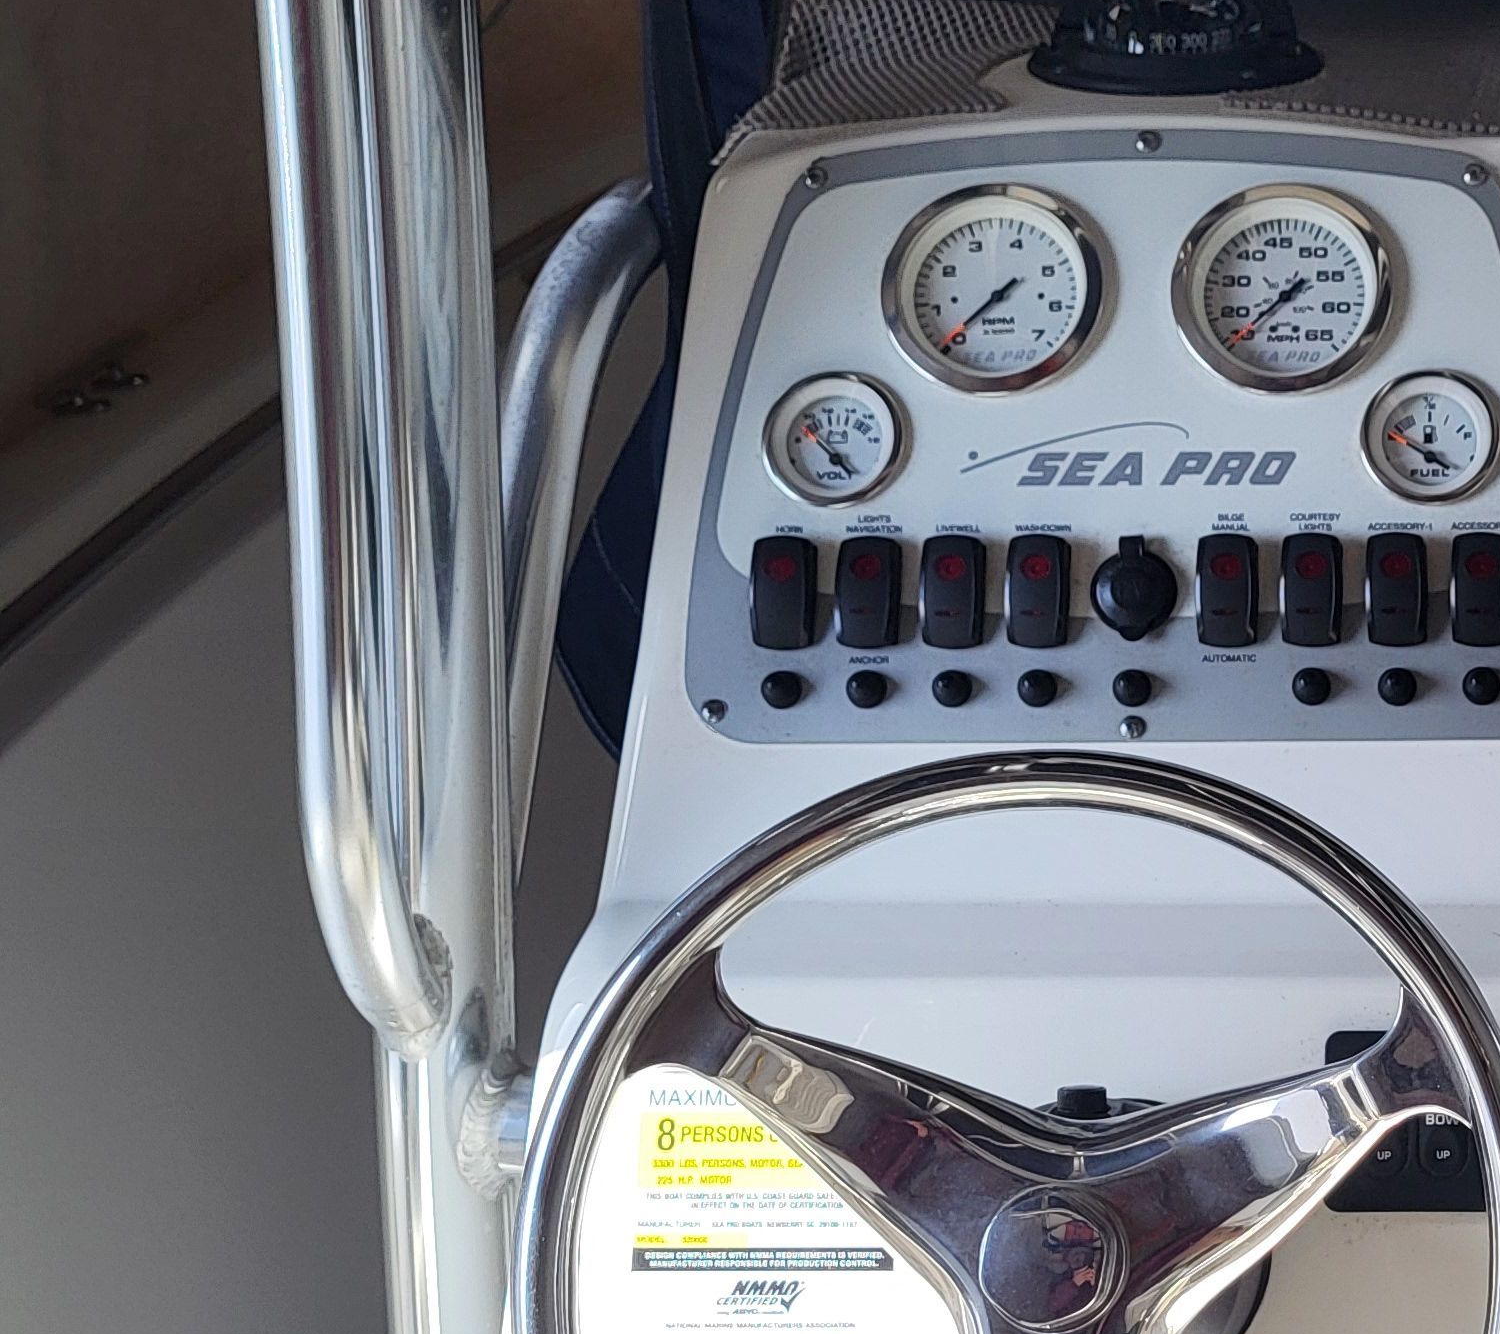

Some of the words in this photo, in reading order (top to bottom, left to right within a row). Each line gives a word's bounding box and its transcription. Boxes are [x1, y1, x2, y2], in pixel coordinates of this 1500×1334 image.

[969, 241, 983, 252] 3
[1010, 239, 1023, 250] 4
[1264, 237, 1293, 248] 45
[1237, 250, 1266, 261] 40
[1299, 247, 1328, 258] 50
[1042, 266, 1055, 277] 5
[1316, 271, 1345, 282] 55
[1222, 276, 1251, 287] 30
[931, 305, 942, 316] 1
[1049, 301, 1063, 312] 6
[1221, 306, 1250, 317] 20
[1322, 302, 1351, 313] 60
[951, 332, 966, 345] 0
[1031, 329, 1046, 341] 7
[1267, 334, 1300, 343] MPH
[1305, 330, 1333, 341] 65
[1285, 350, 1320, 363] PRO
[1016, 451, 1144, 487] SEA
[1160, 451, 1297, 487] PRO
[1410, 468, 1450, 478] FUEL
[1217, 513, 1245, 522] BILGE
[1289, 513, 1341, 522] COURTESY
[1212, 523, 1251, 532] MANUAL
[1367, 522, 1433, 532] ACCESSORY-1
[849, 655, 890, 665] ANCHOR
[1202, 654, 1257, 663] AUTOMATIC
[658, 1118, 675, 1151] 8
[680, 1126, 764, 1142] PERSONS
[1377, 1151, 1392, 1160] UP
[1436, 1150, 1451, 1160] UP
[716, 1296, 779, 1305] CERTIFIED
